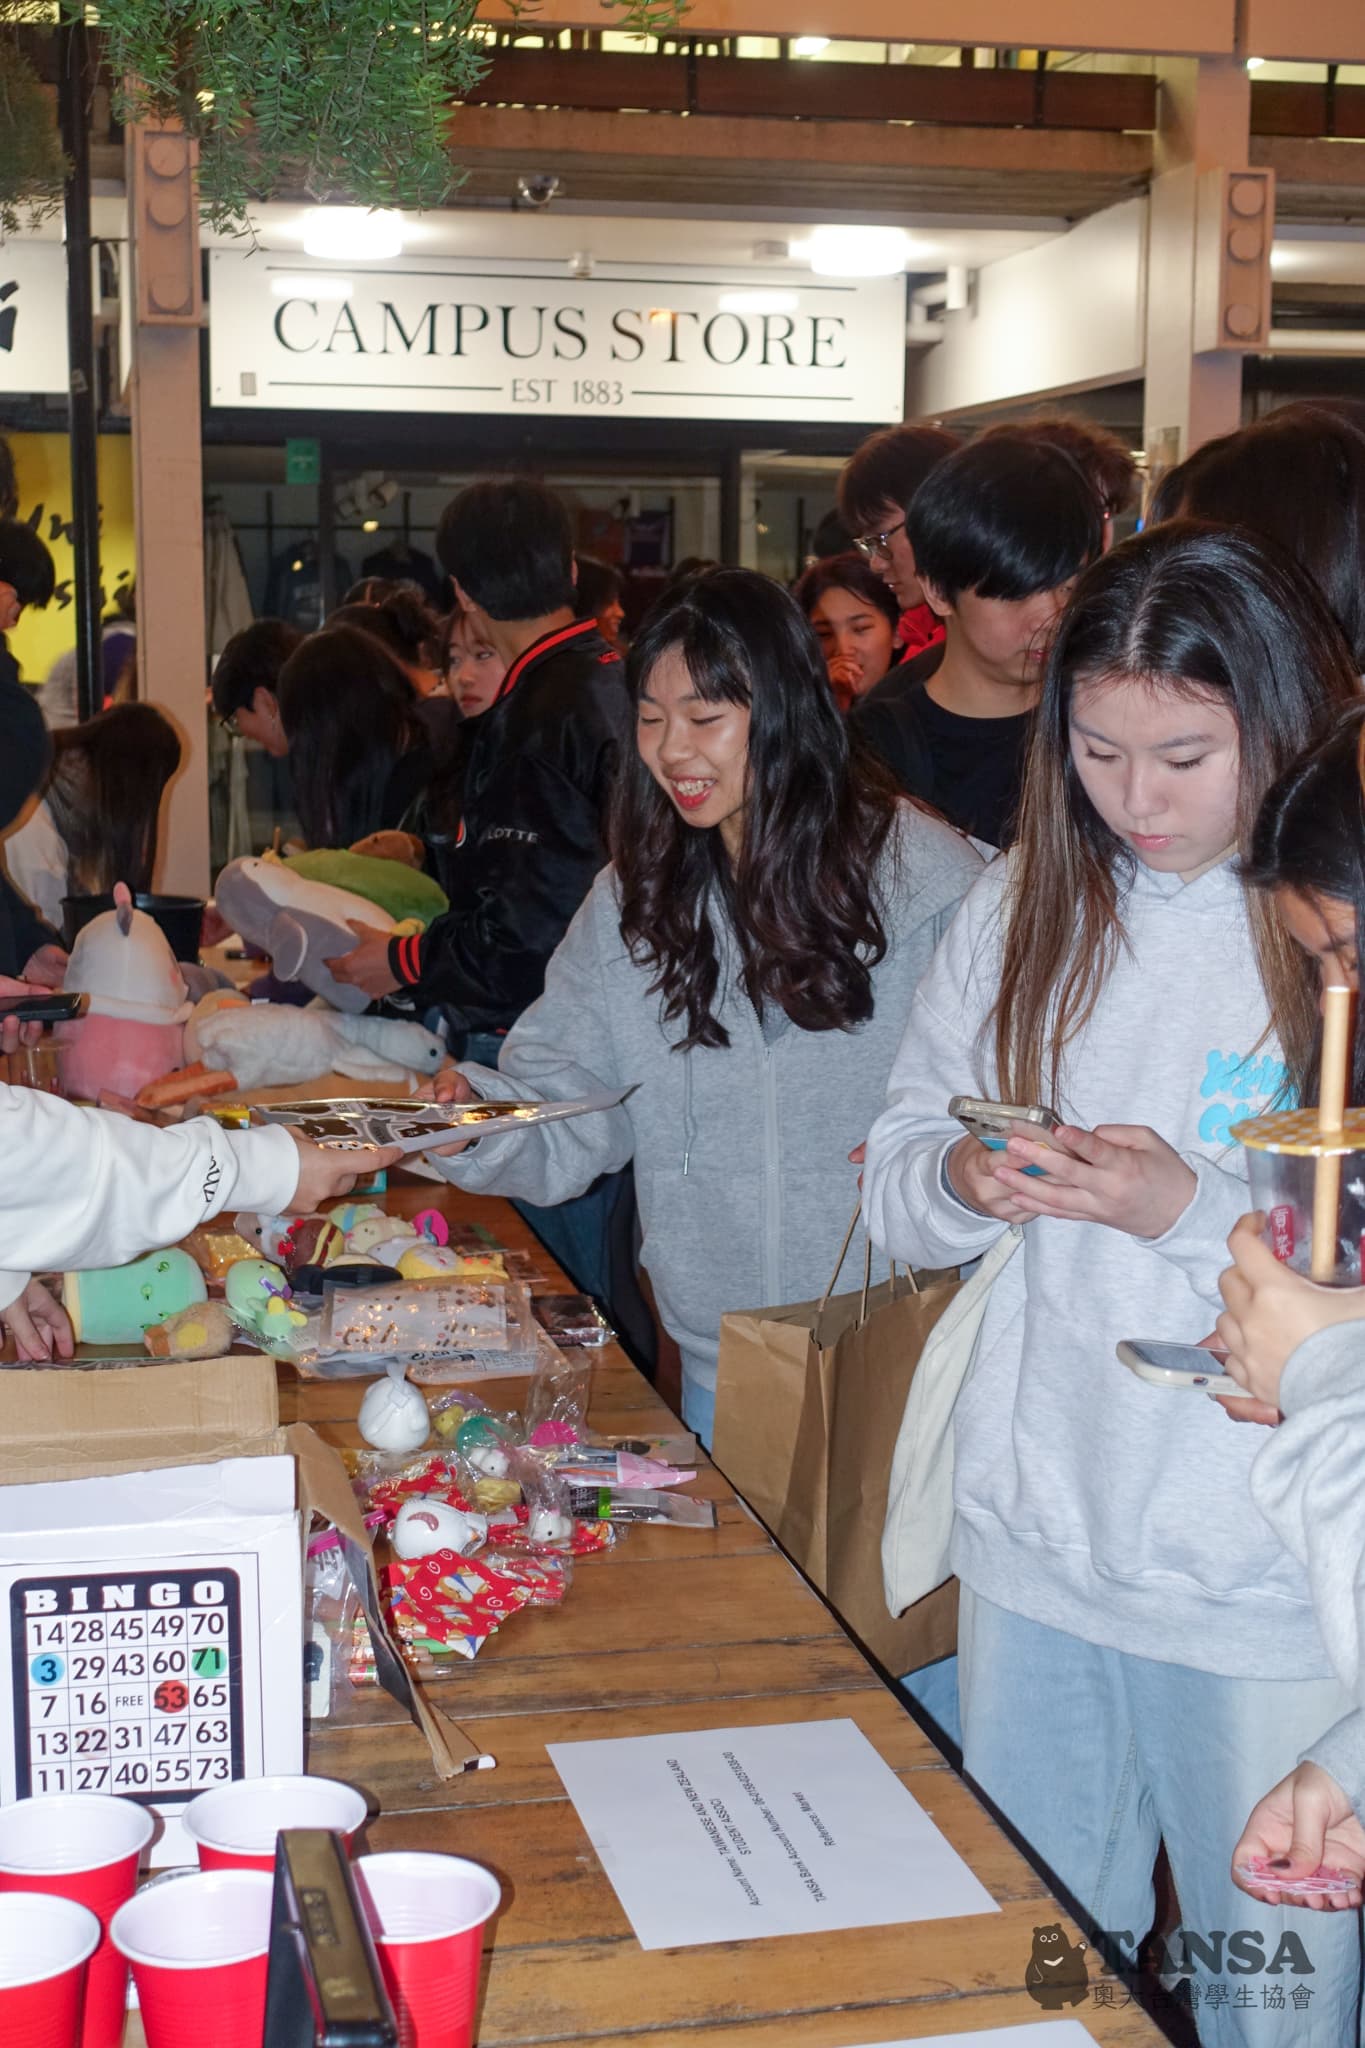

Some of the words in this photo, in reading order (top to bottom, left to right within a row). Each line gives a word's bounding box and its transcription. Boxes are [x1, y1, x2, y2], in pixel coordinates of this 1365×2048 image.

[274, 298, 587, 361] CAMPUS
[611, 308, 847, 369] STORE
[512, 377, 558, 403] EST
[573, 379, 624, 406] 1883
[24, 1580, 225, 1615] BINGO
[33, 1622, 64, 1646] 14
[71, 1620, 105, 1643] 28
[110, 1617, 144, 1640] 45
[151, 1615, 185, 1637] 49
[191, 1612, 225, 1635] 70
[40, 1659, 57, 1683] 3
[72, 1656, 105, 1680] 29
[112, 1653, 145, 1676] 43
[152, 1650, 186, 1674] 60
[192, 1647, 221, 1671] 71
[41, 1695, 58, 1718] 7
[75, 1692, 107, 1716] 16
[115, 1695, 144, 1708] FREE
[193, 1684, 227, 1707] 65
[37, 1732, 69, 1756] 13
[75, 1729, 108, 1753] 22
[114, 1725, 143, 1750] 31
[153, 1723, 187, 1746] 47
[195, 1720, 228, 1744] 63
[38, 1769, 65, 1793] 11
[76, 1766, 110, 1790] 27
[115, 1762, 149, 1786] 40
[155, 1759, 190, 1782] 55
[196, 1757, 229, 1781] 73
[666, 1759, 692, 1787] ZEALAND
[683, 1786, 700, 1802] NEW
[692, 1802, 708, 1816] AND
[792, 1791, 813, 1812] Market
[709, 1798, 732, 1824] ASSOCI
[700, 1817, 730, 1856] TAIWANESE
[725, 1824, 752, 1855] STUDENT
[807, 1812, 836, 1847] Reference:
[775, 1833, 801, 1860] Account
[792, 1861, 812, 1878] Bank
[737, 1878, 762, 1906] Account
[804, 1878, 827, 1902] TANSA
